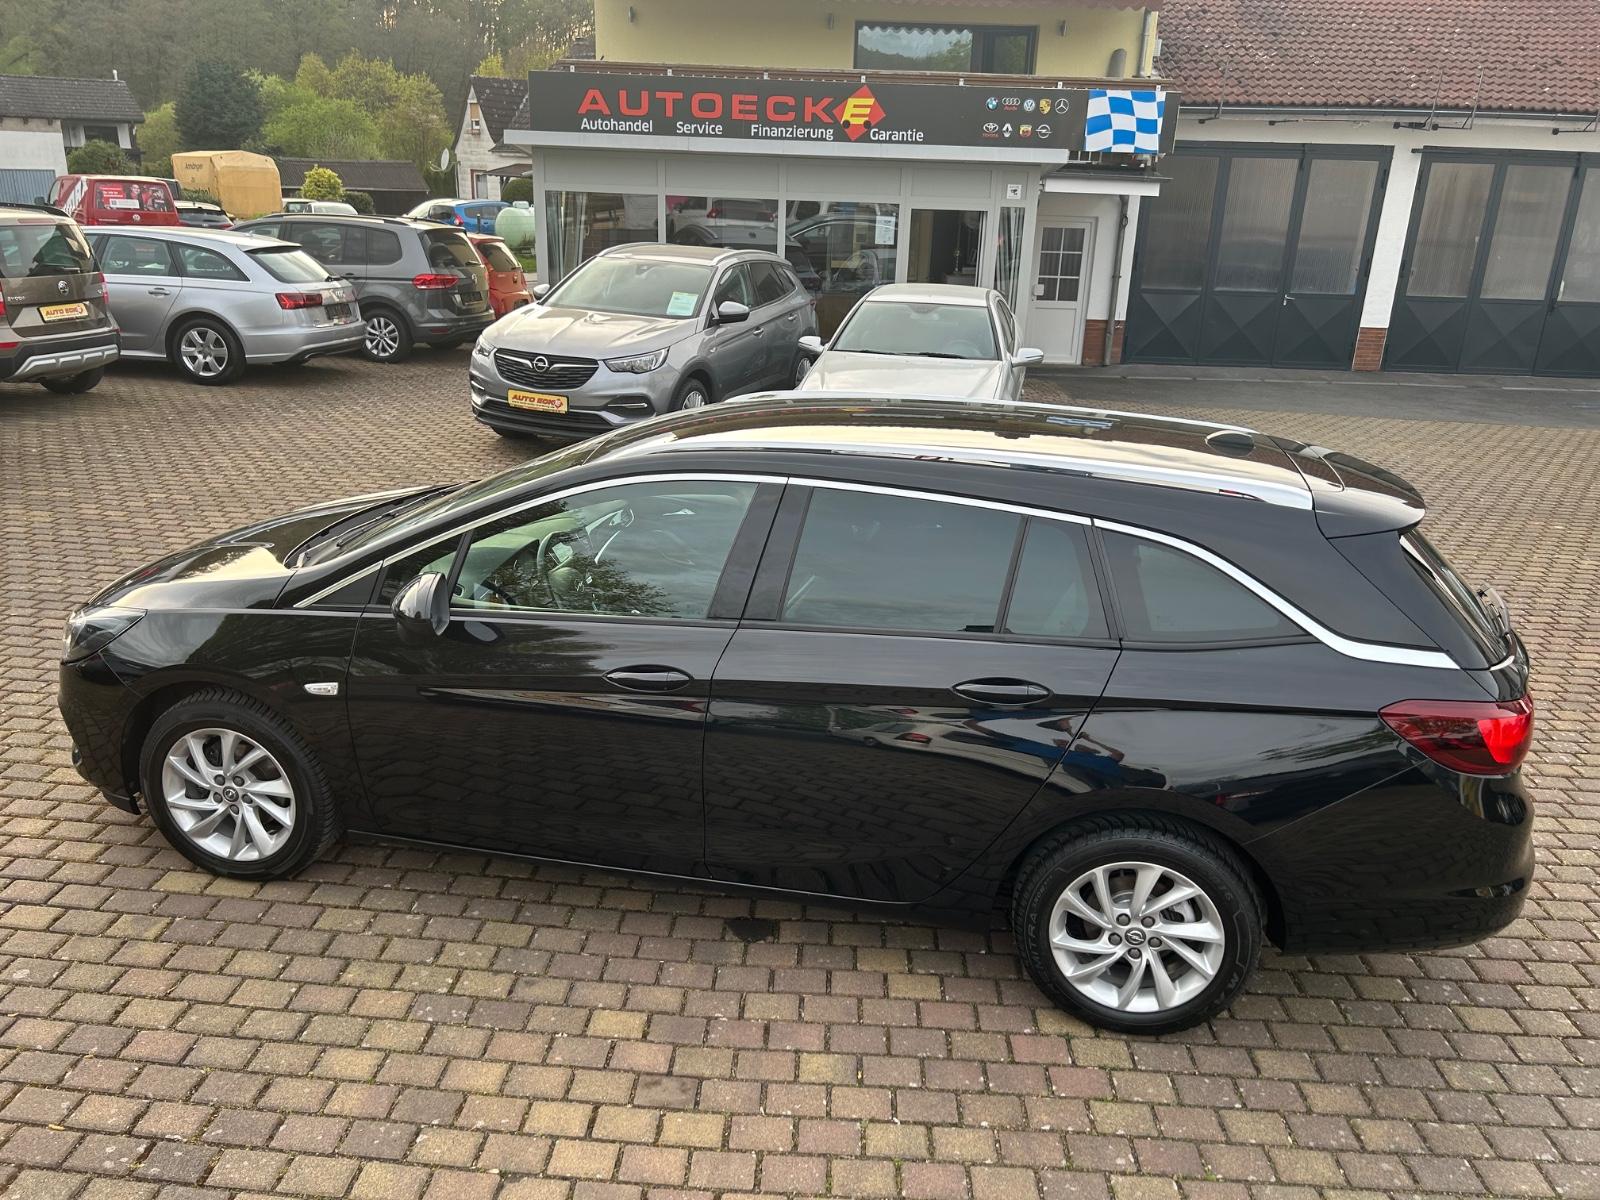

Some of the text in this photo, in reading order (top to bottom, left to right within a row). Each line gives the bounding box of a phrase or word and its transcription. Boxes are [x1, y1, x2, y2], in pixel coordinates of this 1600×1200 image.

[577, 88, 834, 123] AUTOECK
[580, 117, 653, 132] Autohandel
[676, 121, 723, 135] Service
[750, 124, 834, 140] Finanzierung
[869, 128, 924, 142] Garantie
[46, 308, 64, 316] AUTO
[512, 394, 535, 402] AUTO
